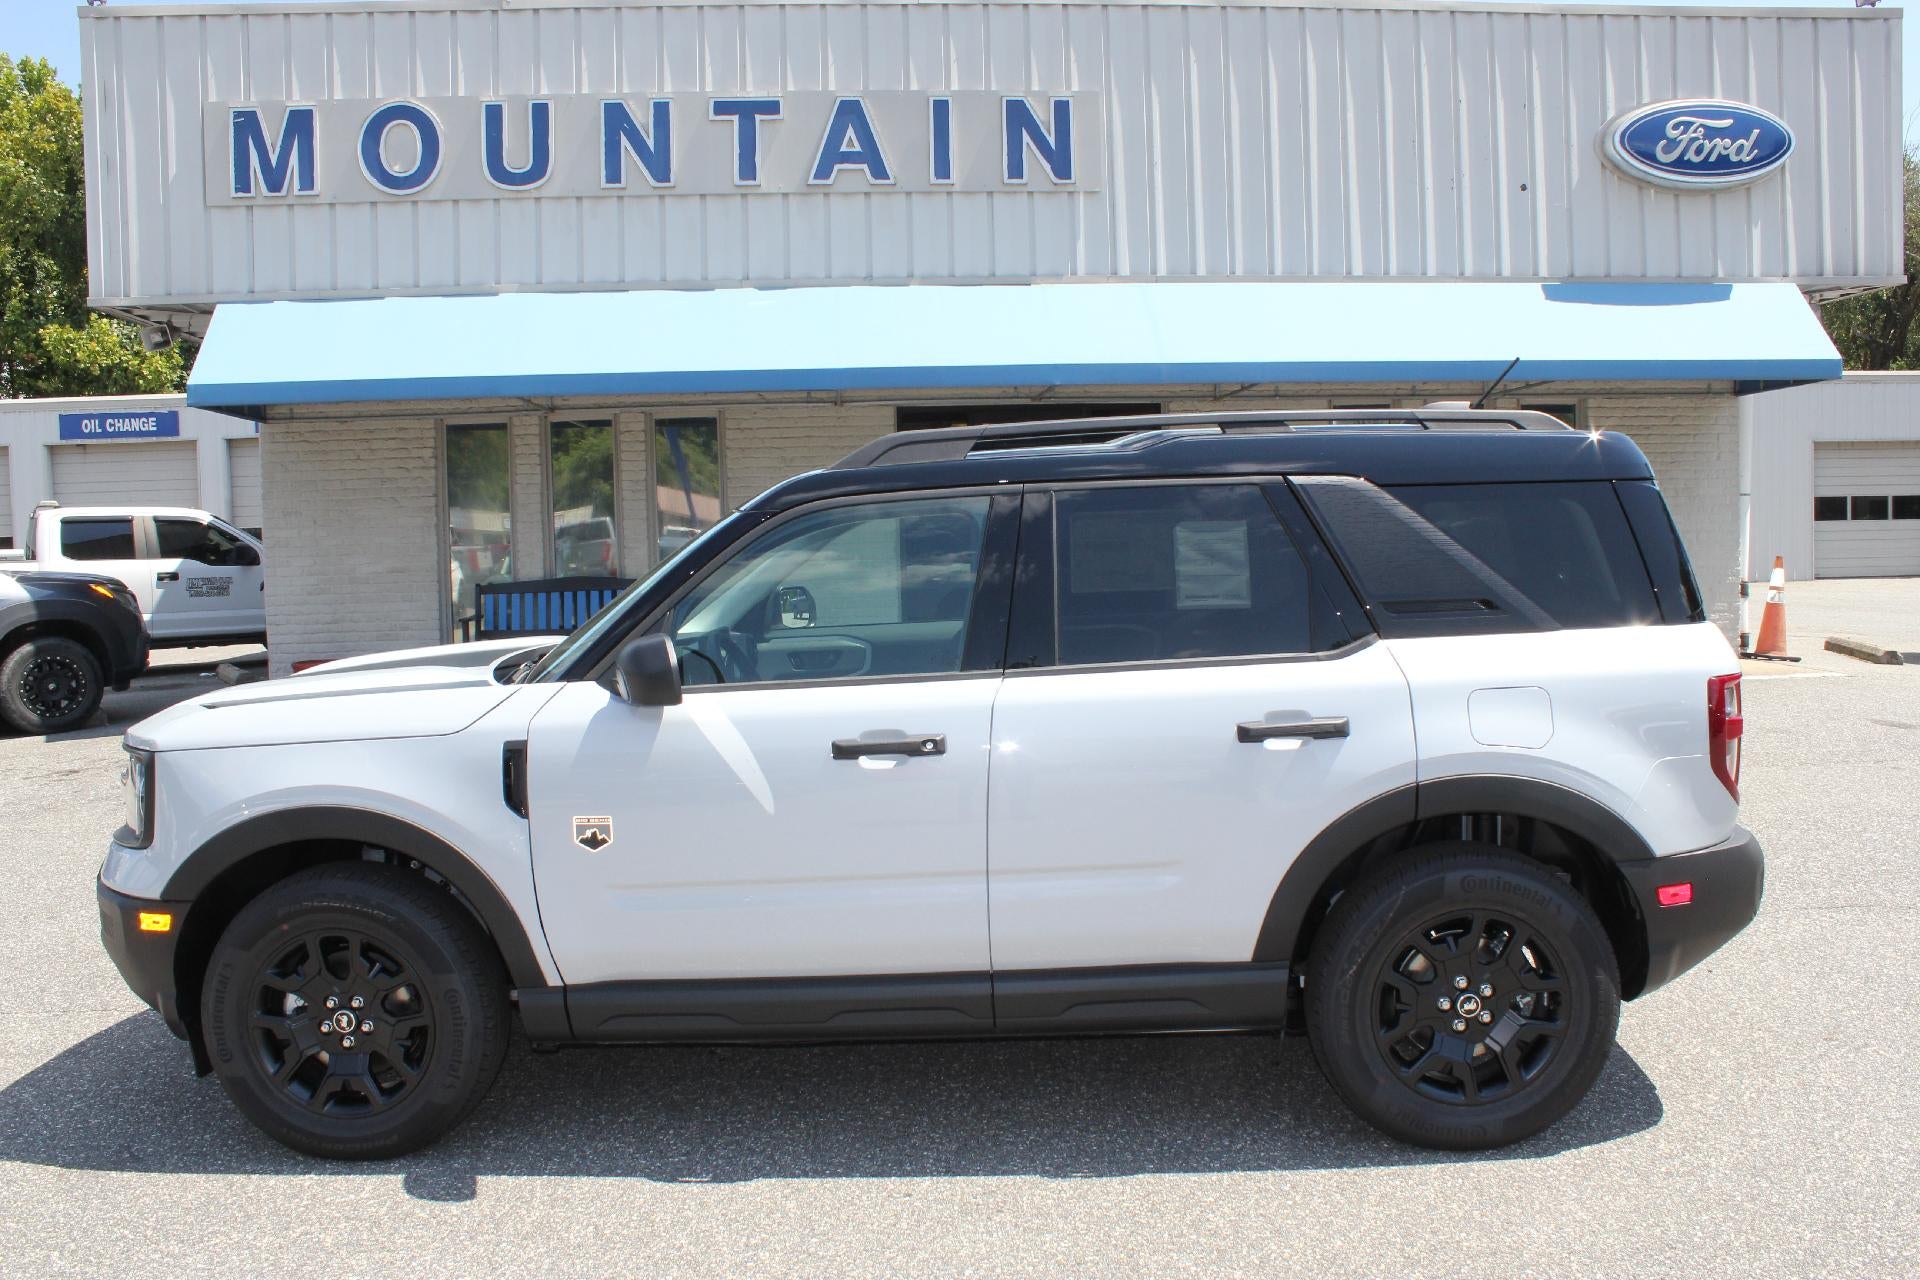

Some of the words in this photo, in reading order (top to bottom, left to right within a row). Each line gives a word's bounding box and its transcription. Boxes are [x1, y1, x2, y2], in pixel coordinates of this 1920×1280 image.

[230, 95, 1076, 198] MOUNTAIN
[1655, 116, 1760, 163] Ford
[81, 418, 103, 434] OIL
[105, 416, 157, 433] CHANGE
[1461, 875, 1554, 907] Continental
[443, 987, 468, 1080] Continental
